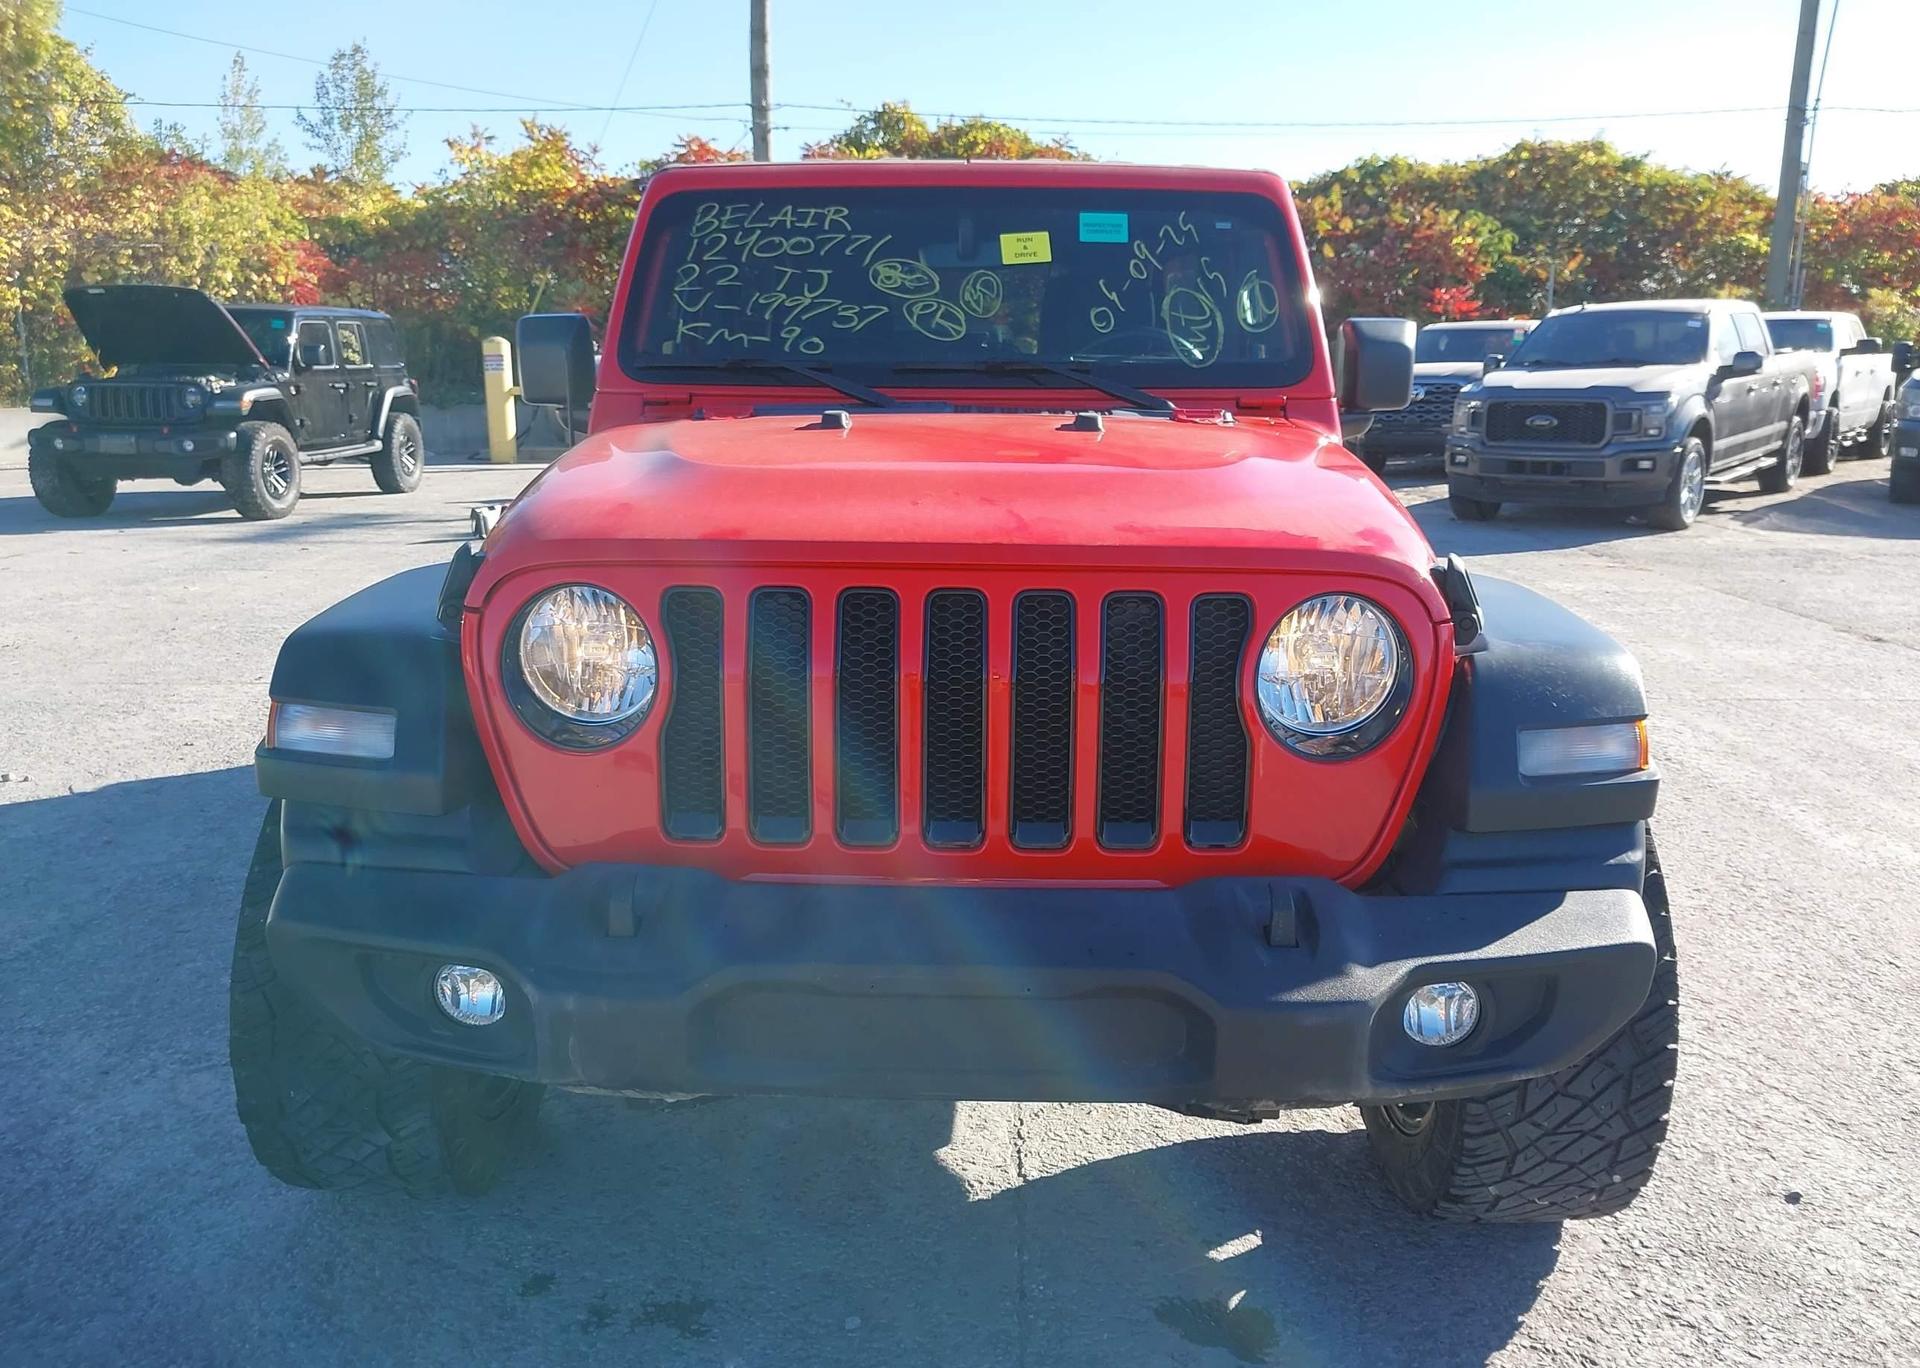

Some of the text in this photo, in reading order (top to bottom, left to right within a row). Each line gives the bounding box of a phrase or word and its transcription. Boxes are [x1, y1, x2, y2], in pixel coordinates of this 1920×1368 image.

[690, 202, 852, 237] BELAIR
[1016, 236, 1033, 244] RUN
[1014, 251, 1038, 259] DRIVE
[673, 263, 744, 291] 22
